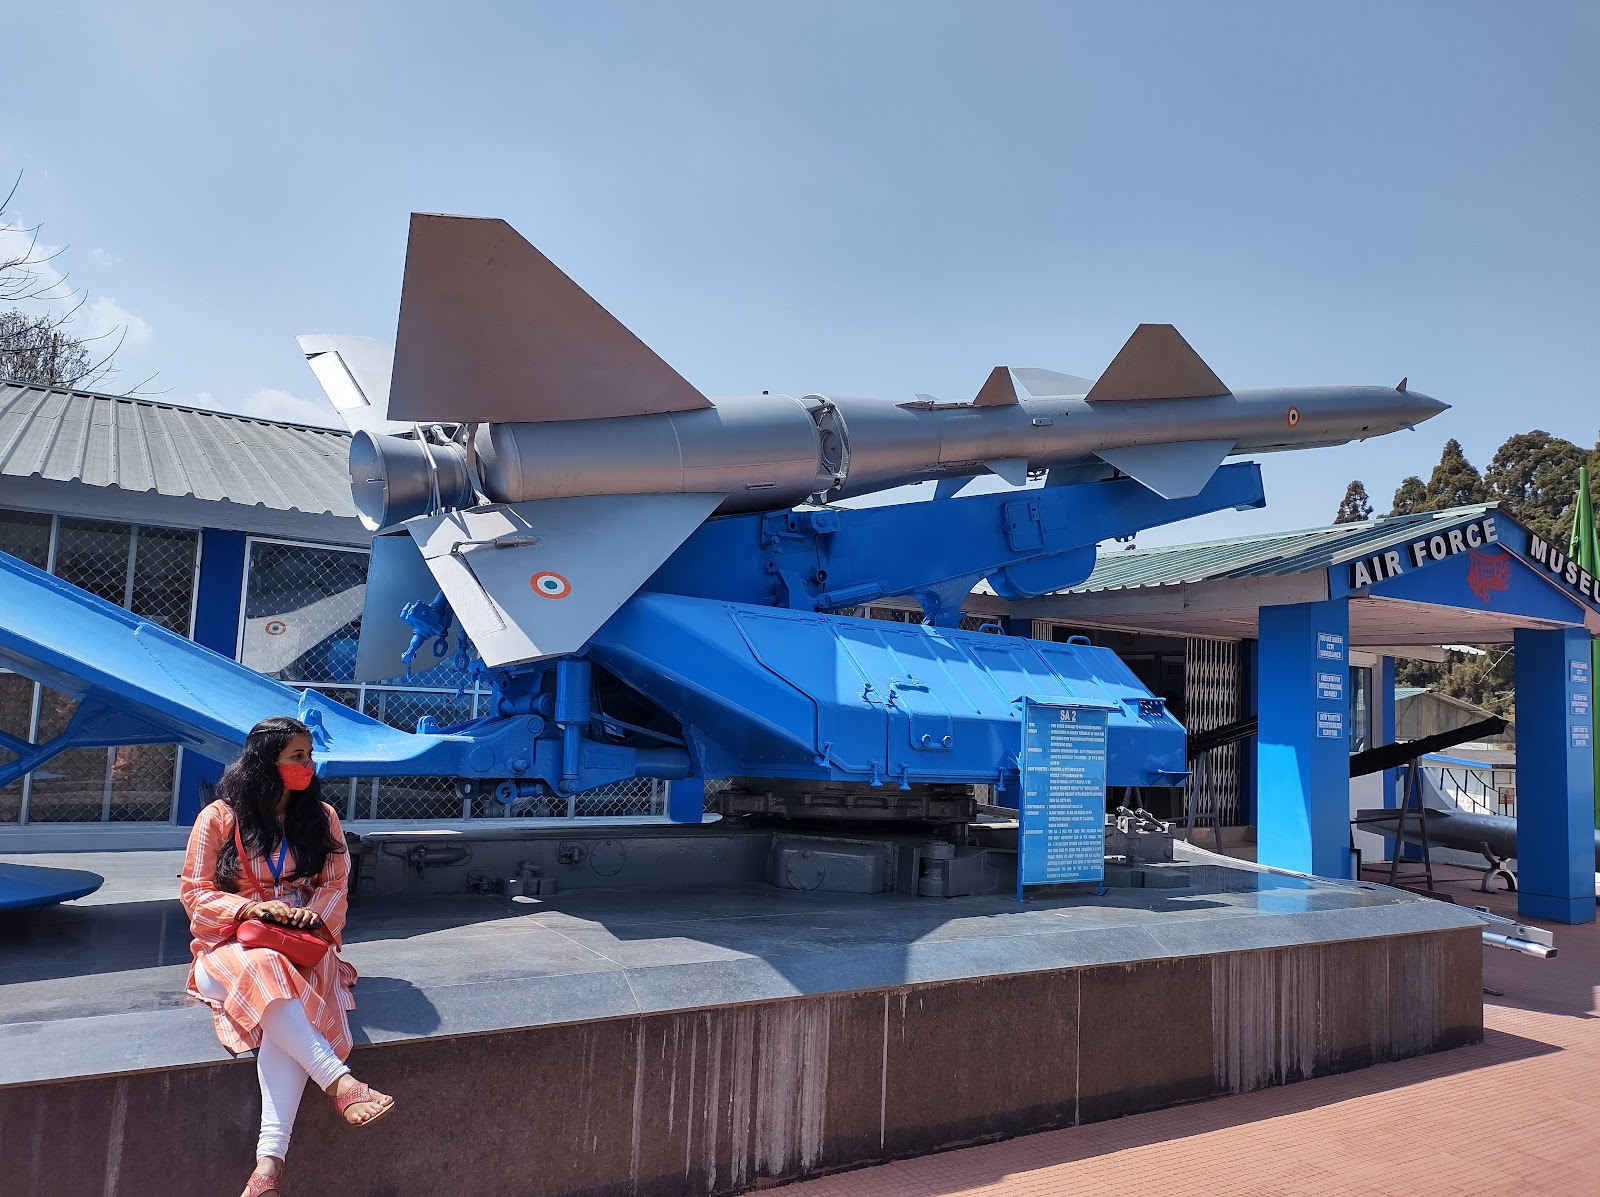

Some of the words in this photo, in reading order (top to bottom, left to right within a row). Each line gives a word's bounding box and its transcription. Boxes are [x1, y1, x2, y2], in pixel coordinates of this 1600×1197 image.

[1352, 550, 1404, 588] AIR
[1411, 517, 1498, 567] FORCE
[1060, 709, 1070, 721] SA
[1071, 710, 1077, 721] 2
